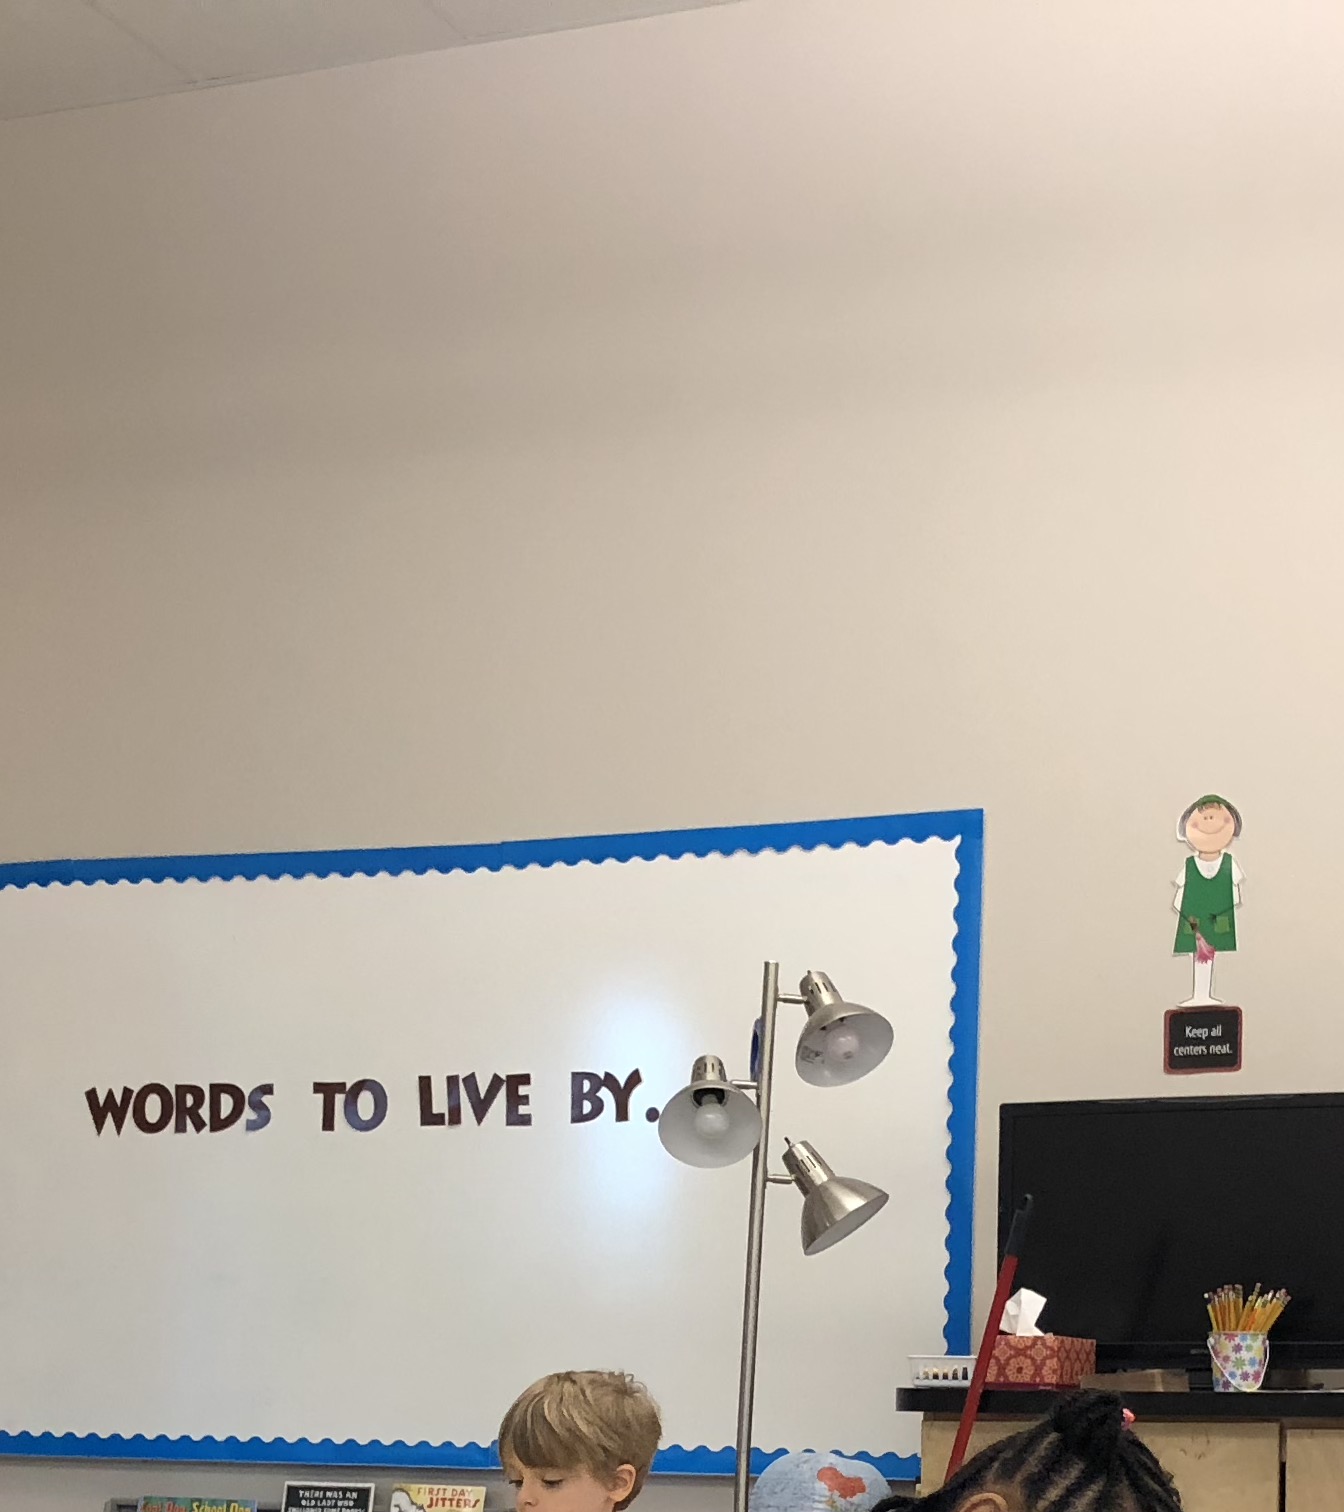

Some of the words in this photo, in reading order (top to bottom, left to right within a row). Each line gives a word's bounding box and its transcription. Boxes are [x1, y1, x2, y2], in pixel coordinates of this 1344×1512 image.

[1185, 1025, 1208, 1039] Keep
[1211, 1024, 1222, 1036] all
[1174, 1045, 1207, 1056] centers
[1209, 1043, 1233, 1055] neat.
[84, 1081, 274, 1138] WORDS
[313, 1078, 388, 1133] TO
[417, 1071, 533, 1129] LIVE
[570, 1067, 660, 1123] BY.
[299, 1489, 323, 1498] THERE
[325, 1491, 343, 1499] WAS
[346, 1491, 358, 1500] AN
[417, 1486, 448, 1496] FIRST
[451, 1487, 474, 1497] DAY
[301, 1499, 315, 1507] OLD
[317, 1499, 335, 1507] LADY
[337, 1500, 354, 1508] WHO
[427, 1498, 481, 1509] JITTERS
